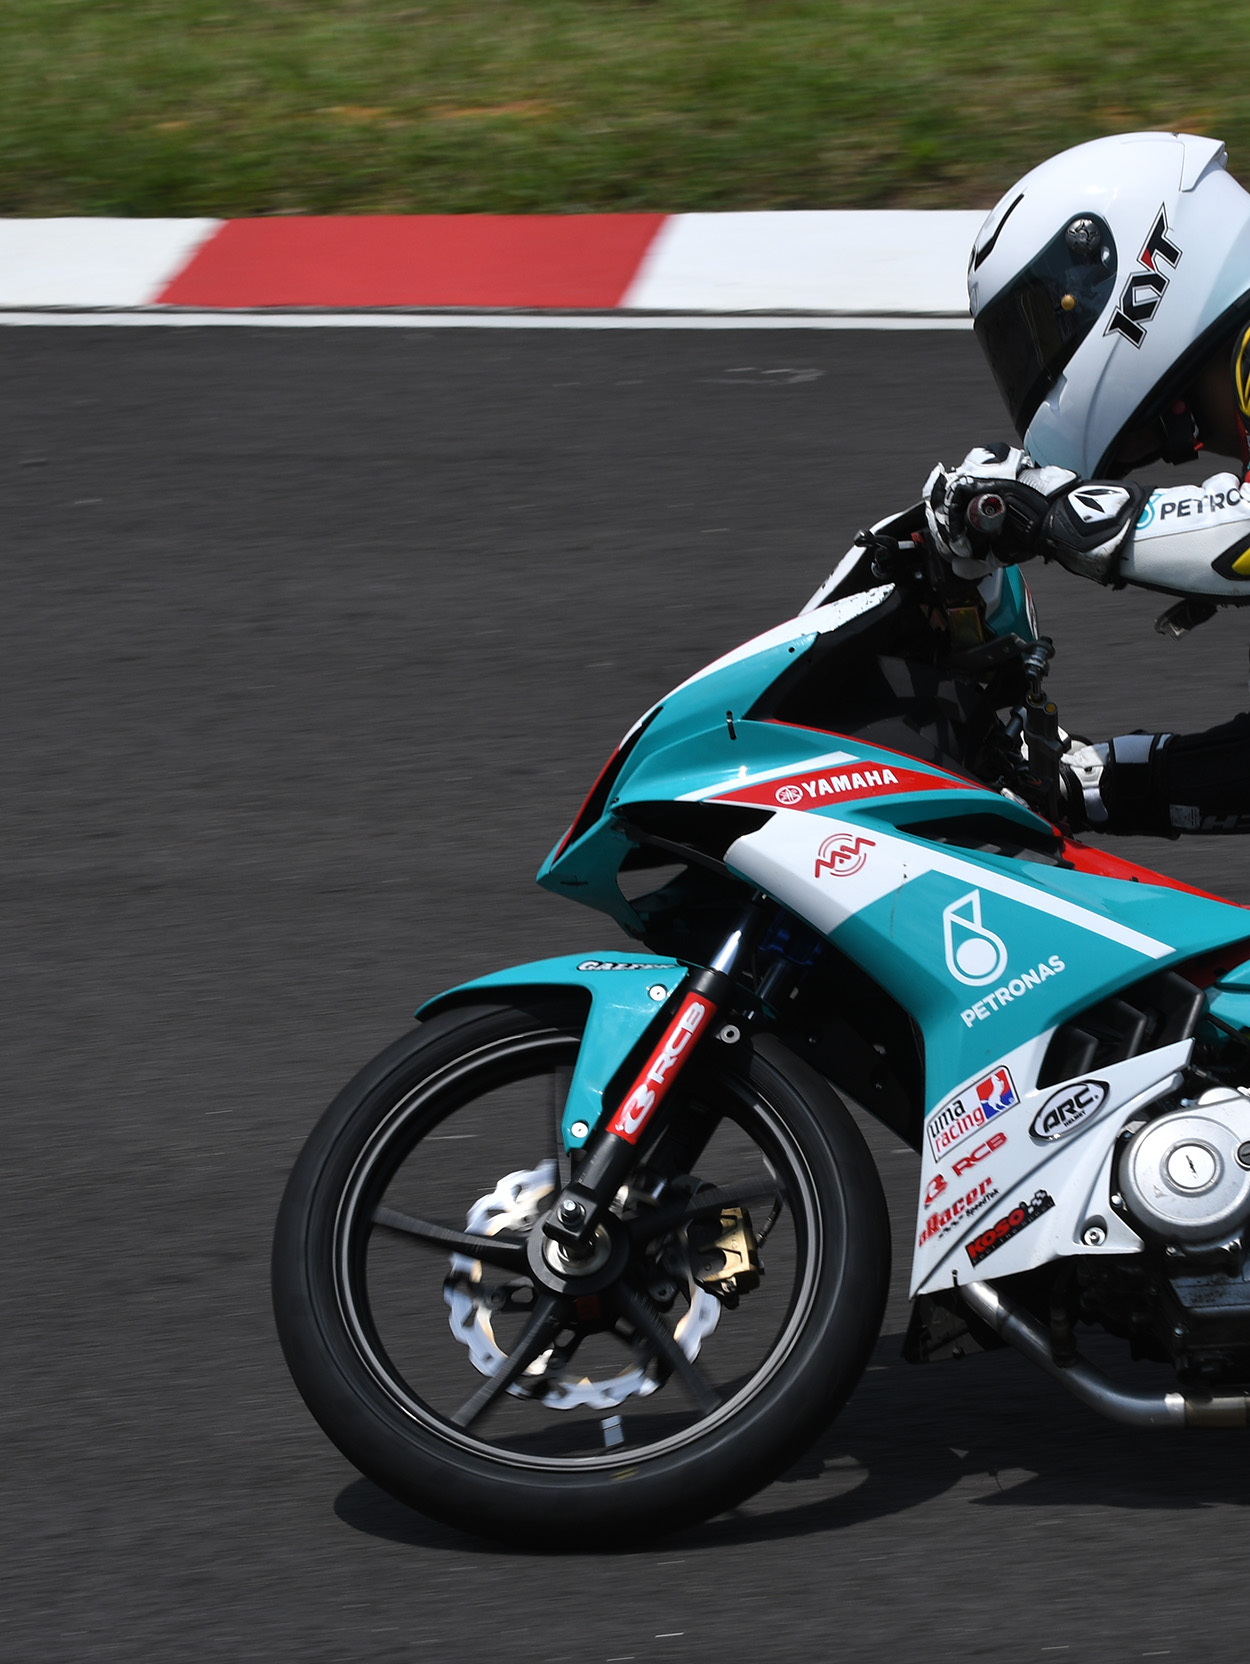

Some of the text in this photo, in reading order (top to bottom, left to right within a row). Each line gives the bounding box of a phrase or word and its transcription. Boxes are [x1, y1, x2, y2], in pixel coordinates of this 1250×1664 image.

[1103, 201, 1183, 350] KYT
[801, 769, 899, 798] YAMAHA
[960, 955, 1066, 1028] PETRONAS
[647, 1001, 706, 1085] RCB
[929, 1099, 966, 1138] uma
[935, 1106, 986, 1153] racing
[951, 1132, 1008, 1176] RCB
[966, 1207, 1025, 1260] KOSO
